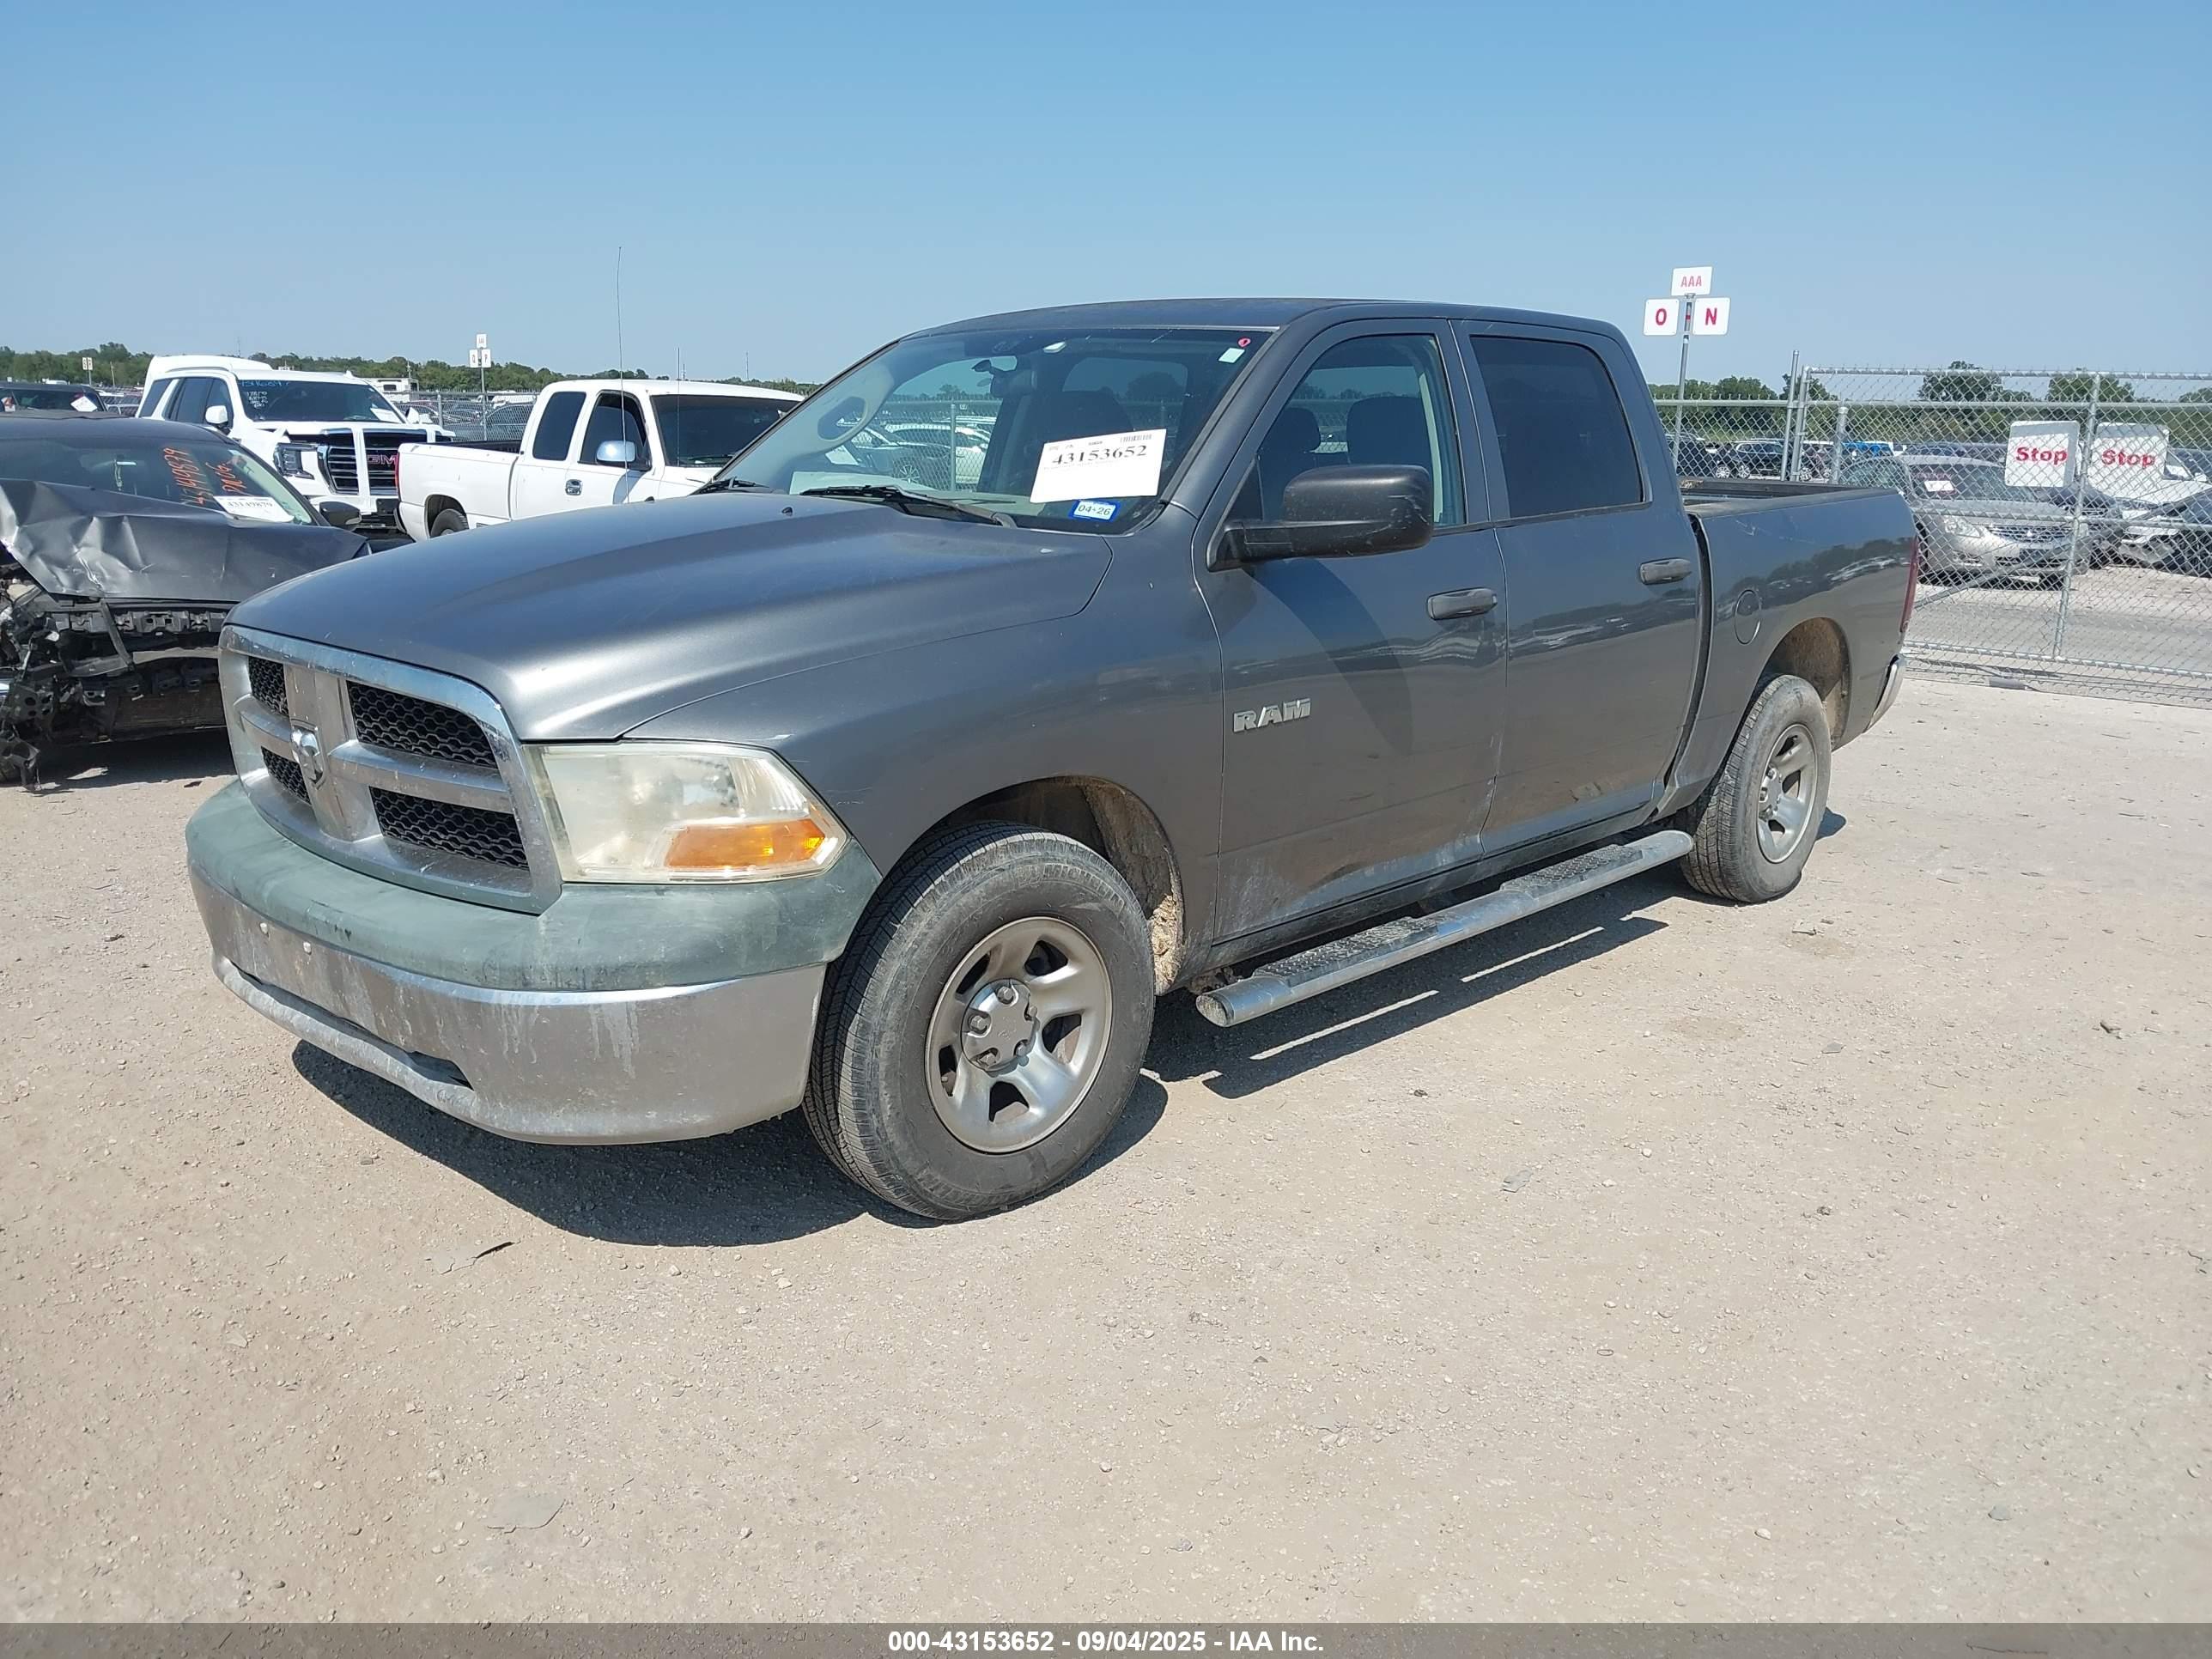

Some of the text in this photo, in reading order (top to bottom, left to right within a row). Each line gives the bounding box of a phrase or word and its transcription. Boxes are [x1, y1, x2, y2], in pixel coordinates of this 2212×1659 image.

[1680, 276, 1702, 288] AAA
[1655, 307, 1668, 326] O
[1705, 307, 1718, 325] N
[367, 454, 398, 465] GM
[1052, 444, 1147, 465] 43153652
[2015, 447, 2068, 465] Stop
[2101, 449, 2156, 469] Stop
[1233, 698, 1311, 732] RAM
